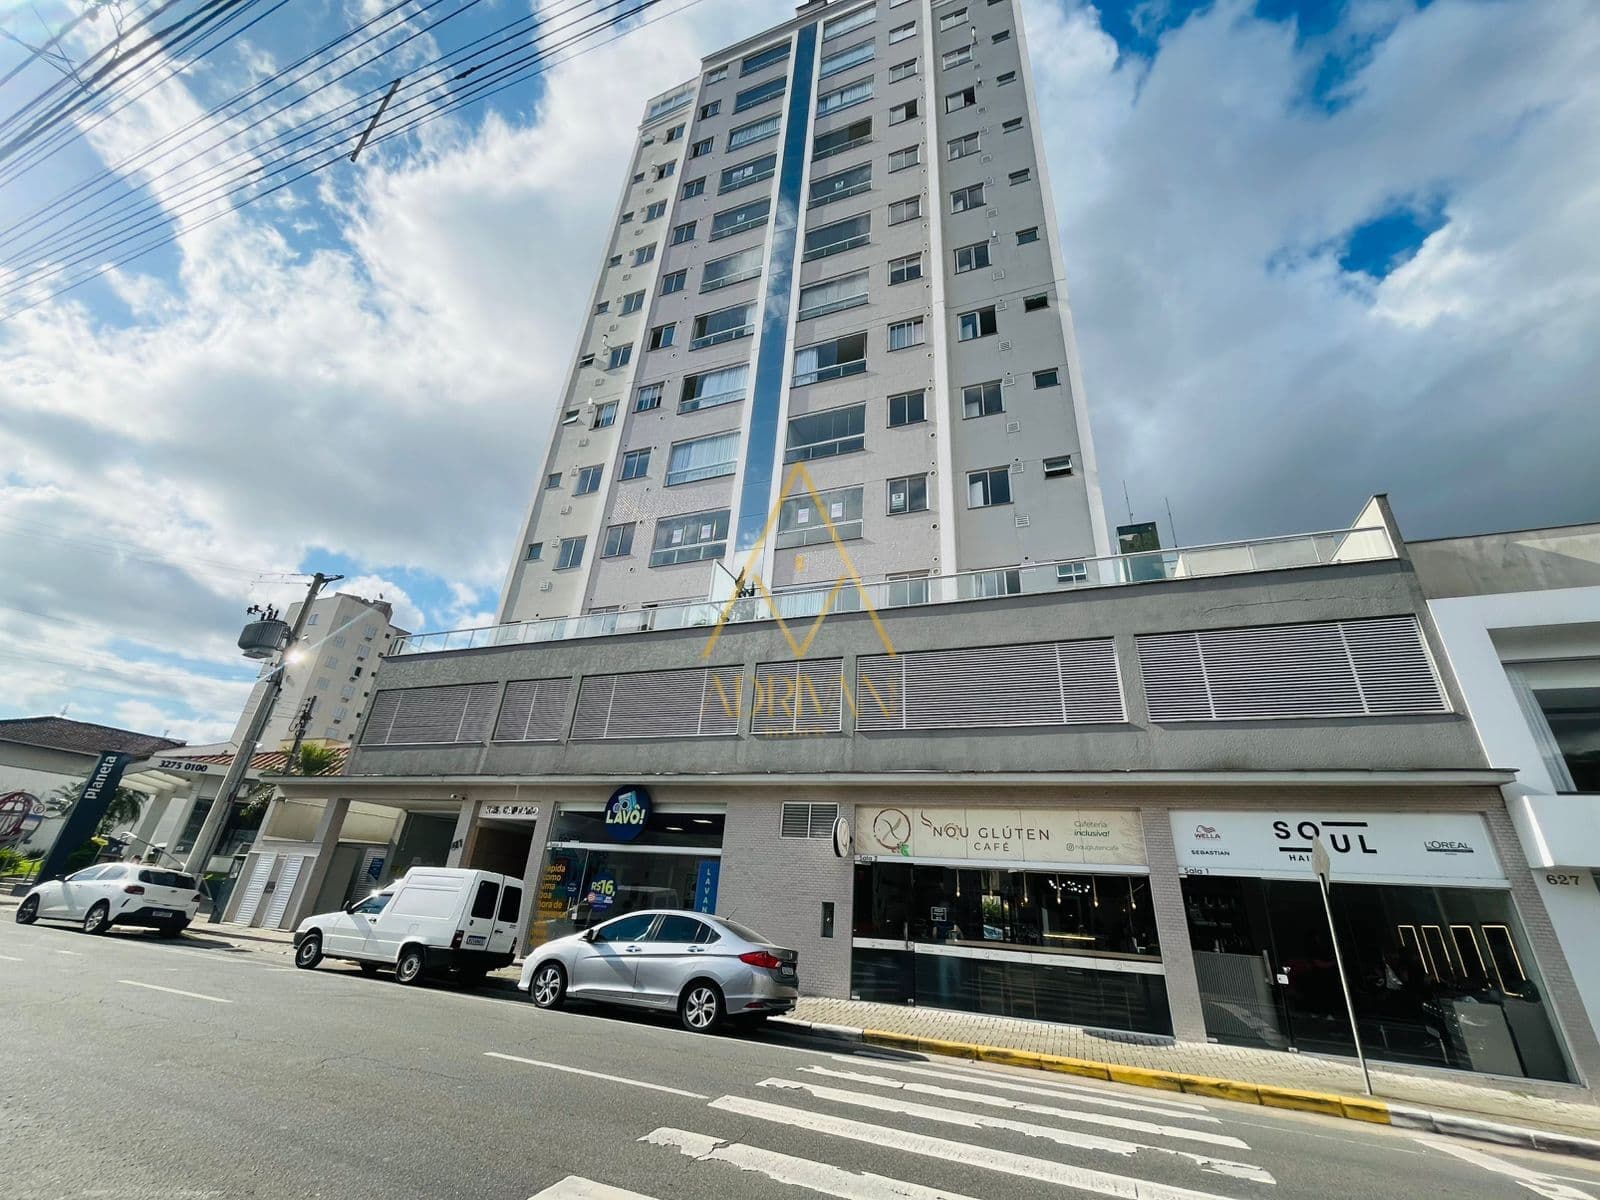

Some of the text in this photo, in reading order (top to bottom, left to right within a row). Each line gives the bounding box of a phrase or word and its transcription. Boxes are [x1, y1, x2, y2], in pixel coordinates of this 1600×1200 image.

[158, 760, 209, 773] 3275 0100
[84, 754, 118, 799] Planeta
[605, 803, 646, 825] LAVÔ!
[933, 826, 1050, 841] NOU GLÚTEN
[1073, 829, 1111, 838] inclusiva!
[1273, 820, 1378, 854] SOUL
[973, 841, 1010, 852] CAFÉ
[1190, 849, 1231, 857] SEBASTIAN
[1288, 854, 1312, 863] HAI
[1184, 867, 1203, 875] Sala
[1546, 875, 1580, 886] 627
